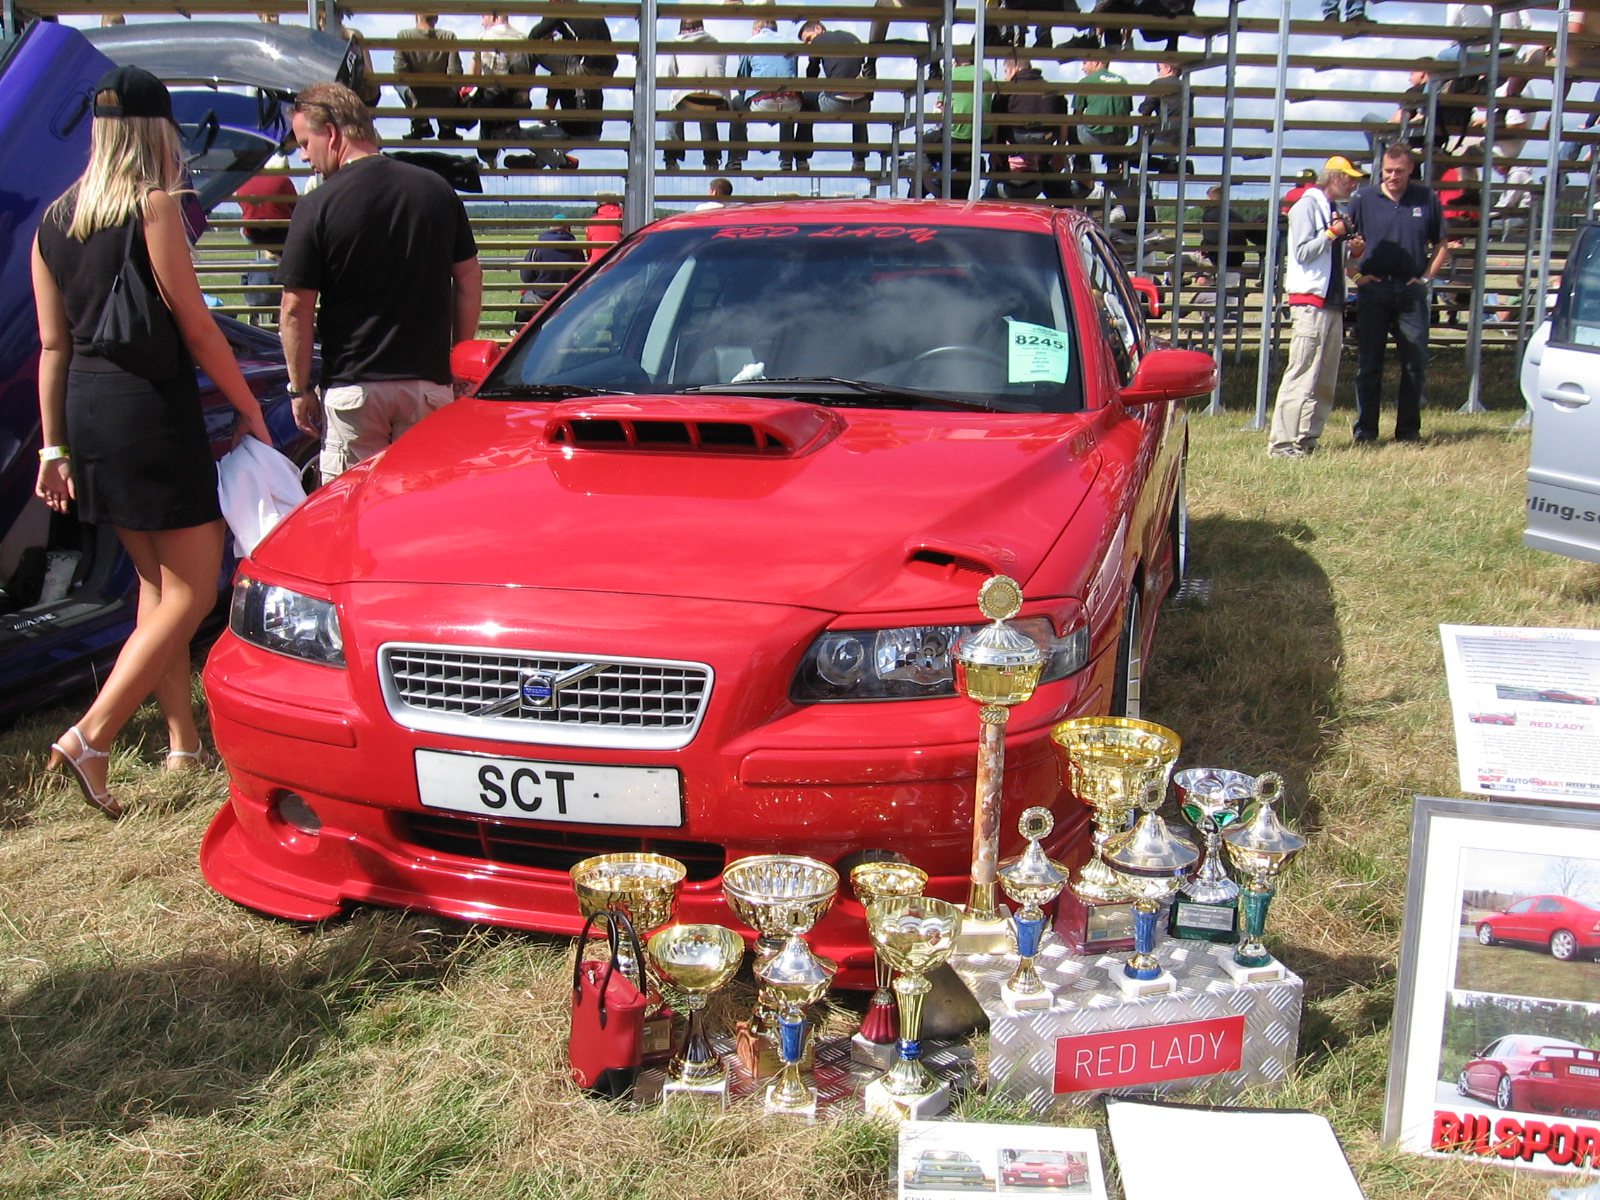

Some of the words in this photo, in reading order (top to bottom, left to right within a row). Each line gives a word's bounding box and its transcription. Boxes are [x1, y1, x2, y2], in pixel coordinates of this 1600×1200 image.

[711, 226, 800, 240] RED
[808, 226, 939, 243] LADY
[1015, 335, 1064, 350] 8245
[1529, 720, 1552, 729] RED
[1555, 722, 1585, 731] LADY
[478, 764, 574, 815] SCT
[792, 911, 800, 925] 1
[1074, 1043, 1136, 1079] RED
[1150, 1030, 1225, 1069] LADY
